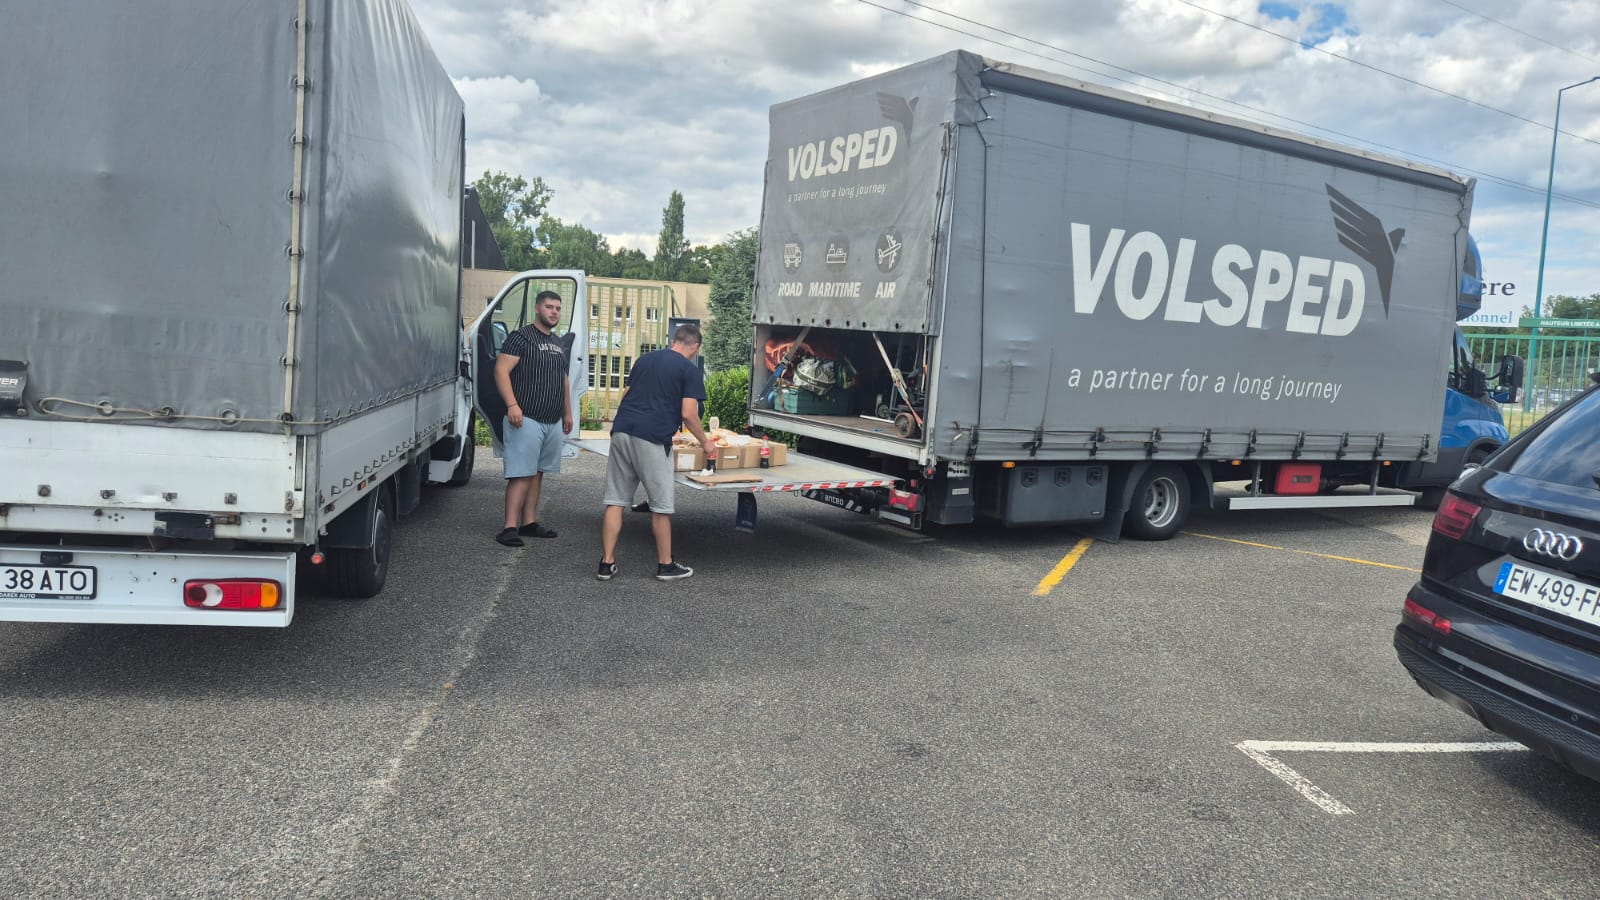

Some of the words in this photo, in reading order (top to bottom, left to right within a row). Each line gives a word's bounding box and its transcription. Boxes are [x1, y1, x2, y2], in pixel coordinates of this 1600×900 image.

[788, 126, 898, 182] VOLSPED
[793, 191, 818, 204] partner
[819, 187, 830, 200] for
[831, 188, 837, 198] a
[838, 185, 855, 199] long
[855, 183, 887, 198] journey
[778, 282, 803, 297] ROAD
[808, 281, 861, 298] MARITIME
[875, 282, 896, 298] AIR
[1070, 222, 1366, 337] VOLSPED
[0, 377, 18, 385] ER
[1068, 368, 1081, 387] a
[1090, 367, 1173, 393] partner
[1179, 368, 1208, 392] for
[1214, 374, 1226, 393] a
[1232, 372, 1274, 400] long
[1274, 374, 1342, 404] journey
[5, 568, 33, 590] 38
[40, 569, 87, 592] ATO
[1508, 567, 1600, 616] EW-499-F
